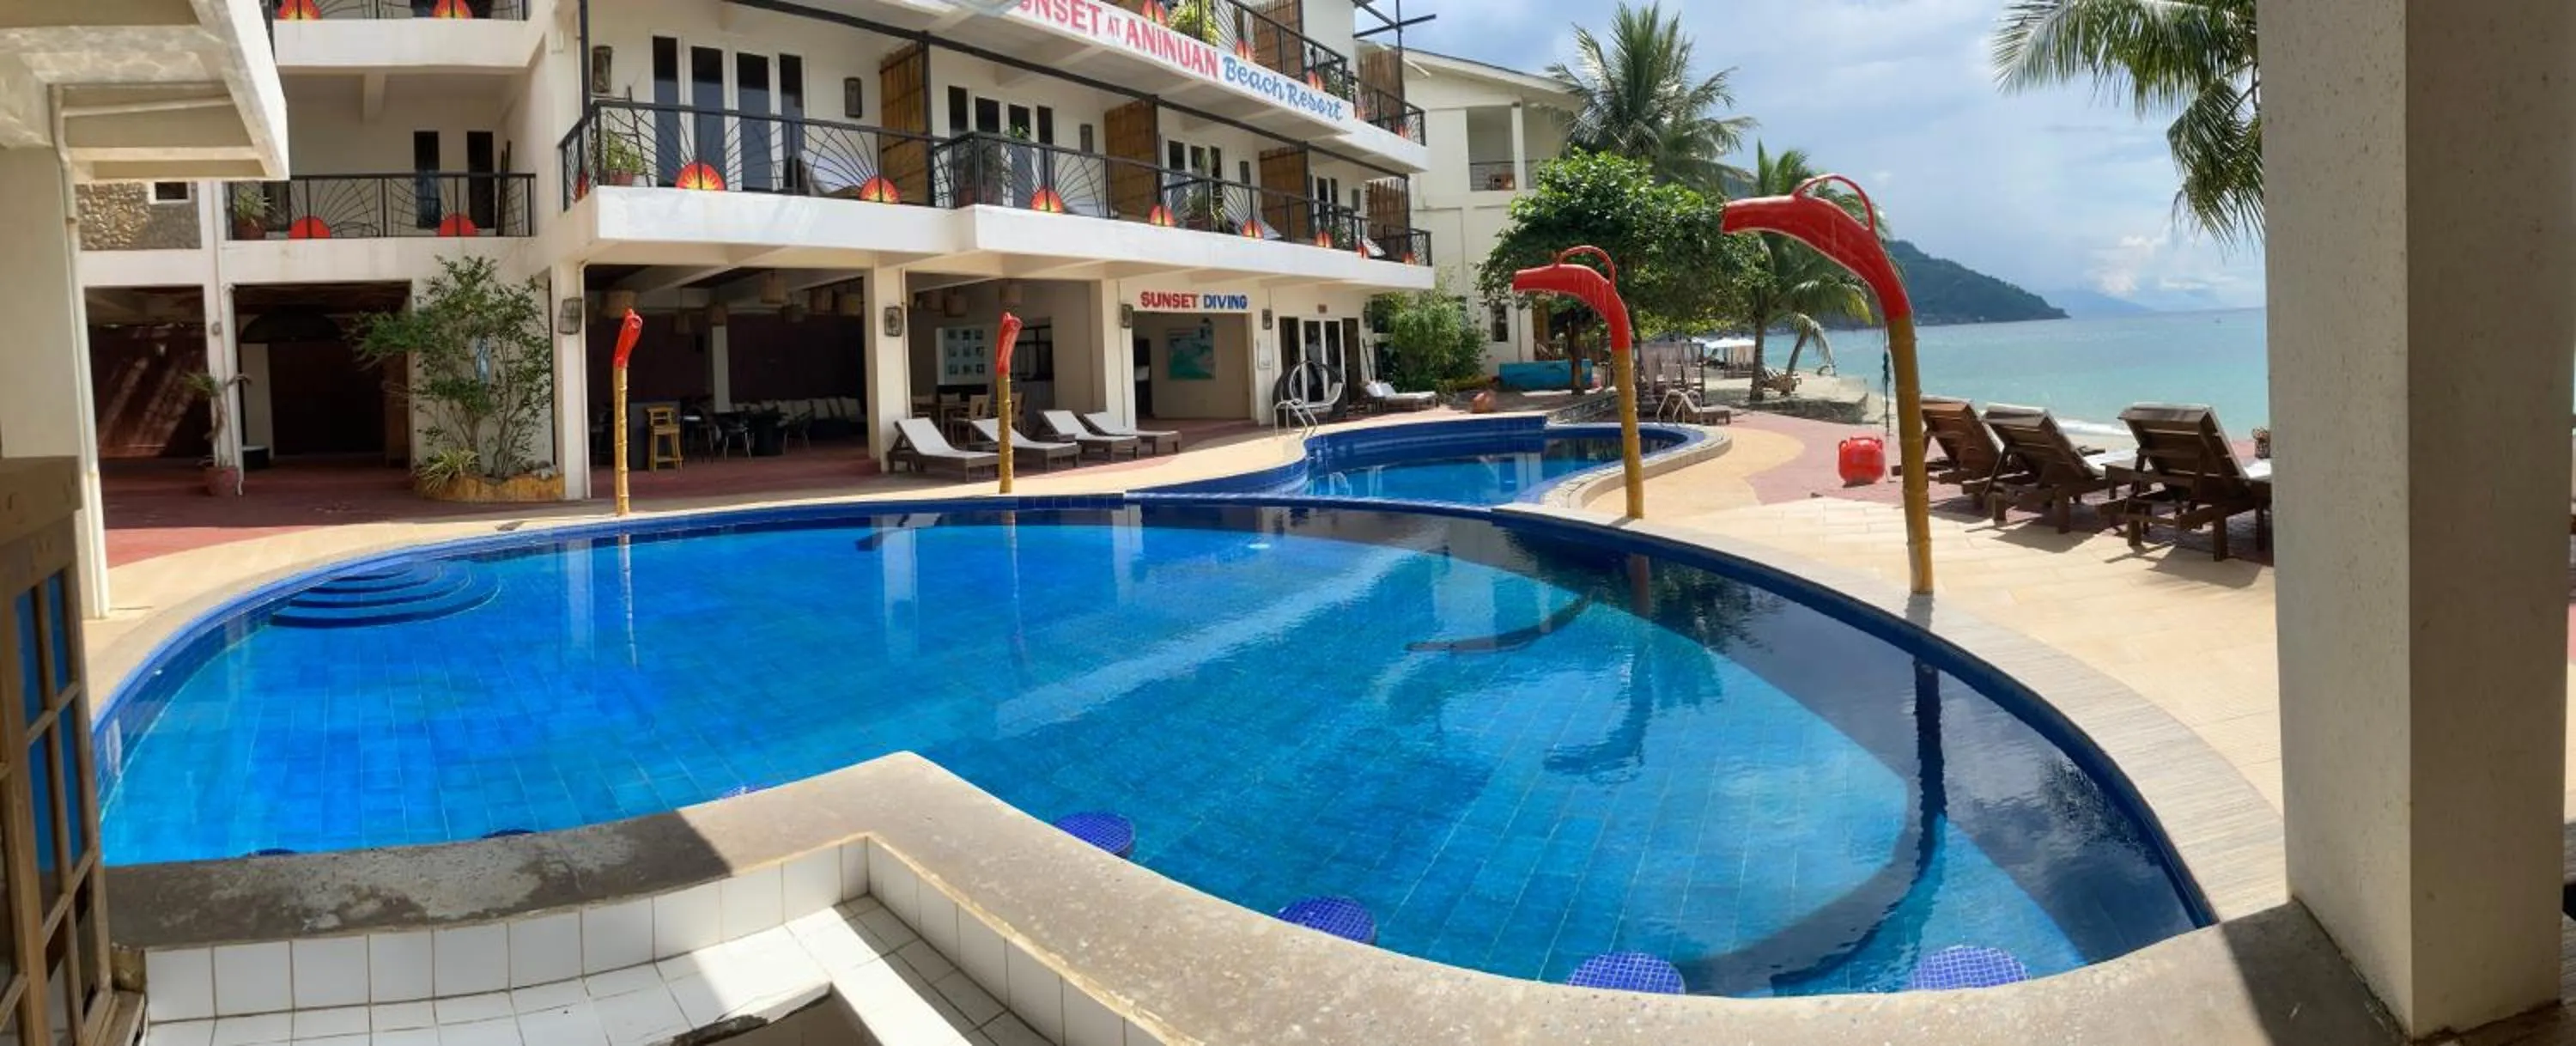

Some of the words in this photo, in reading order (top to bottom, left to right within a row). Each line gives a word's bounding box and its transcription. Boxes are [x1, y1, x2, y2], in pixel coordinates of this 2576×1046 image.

[1126, 18, 1218, 80] ANINUAN
[1223, 56, 1285, 100] Beach
[1287, 82, 1343, 120] Resort
[1140, 292, 1199, 308] SUNSET
[1203, 295, 1248, 309] DIVING
